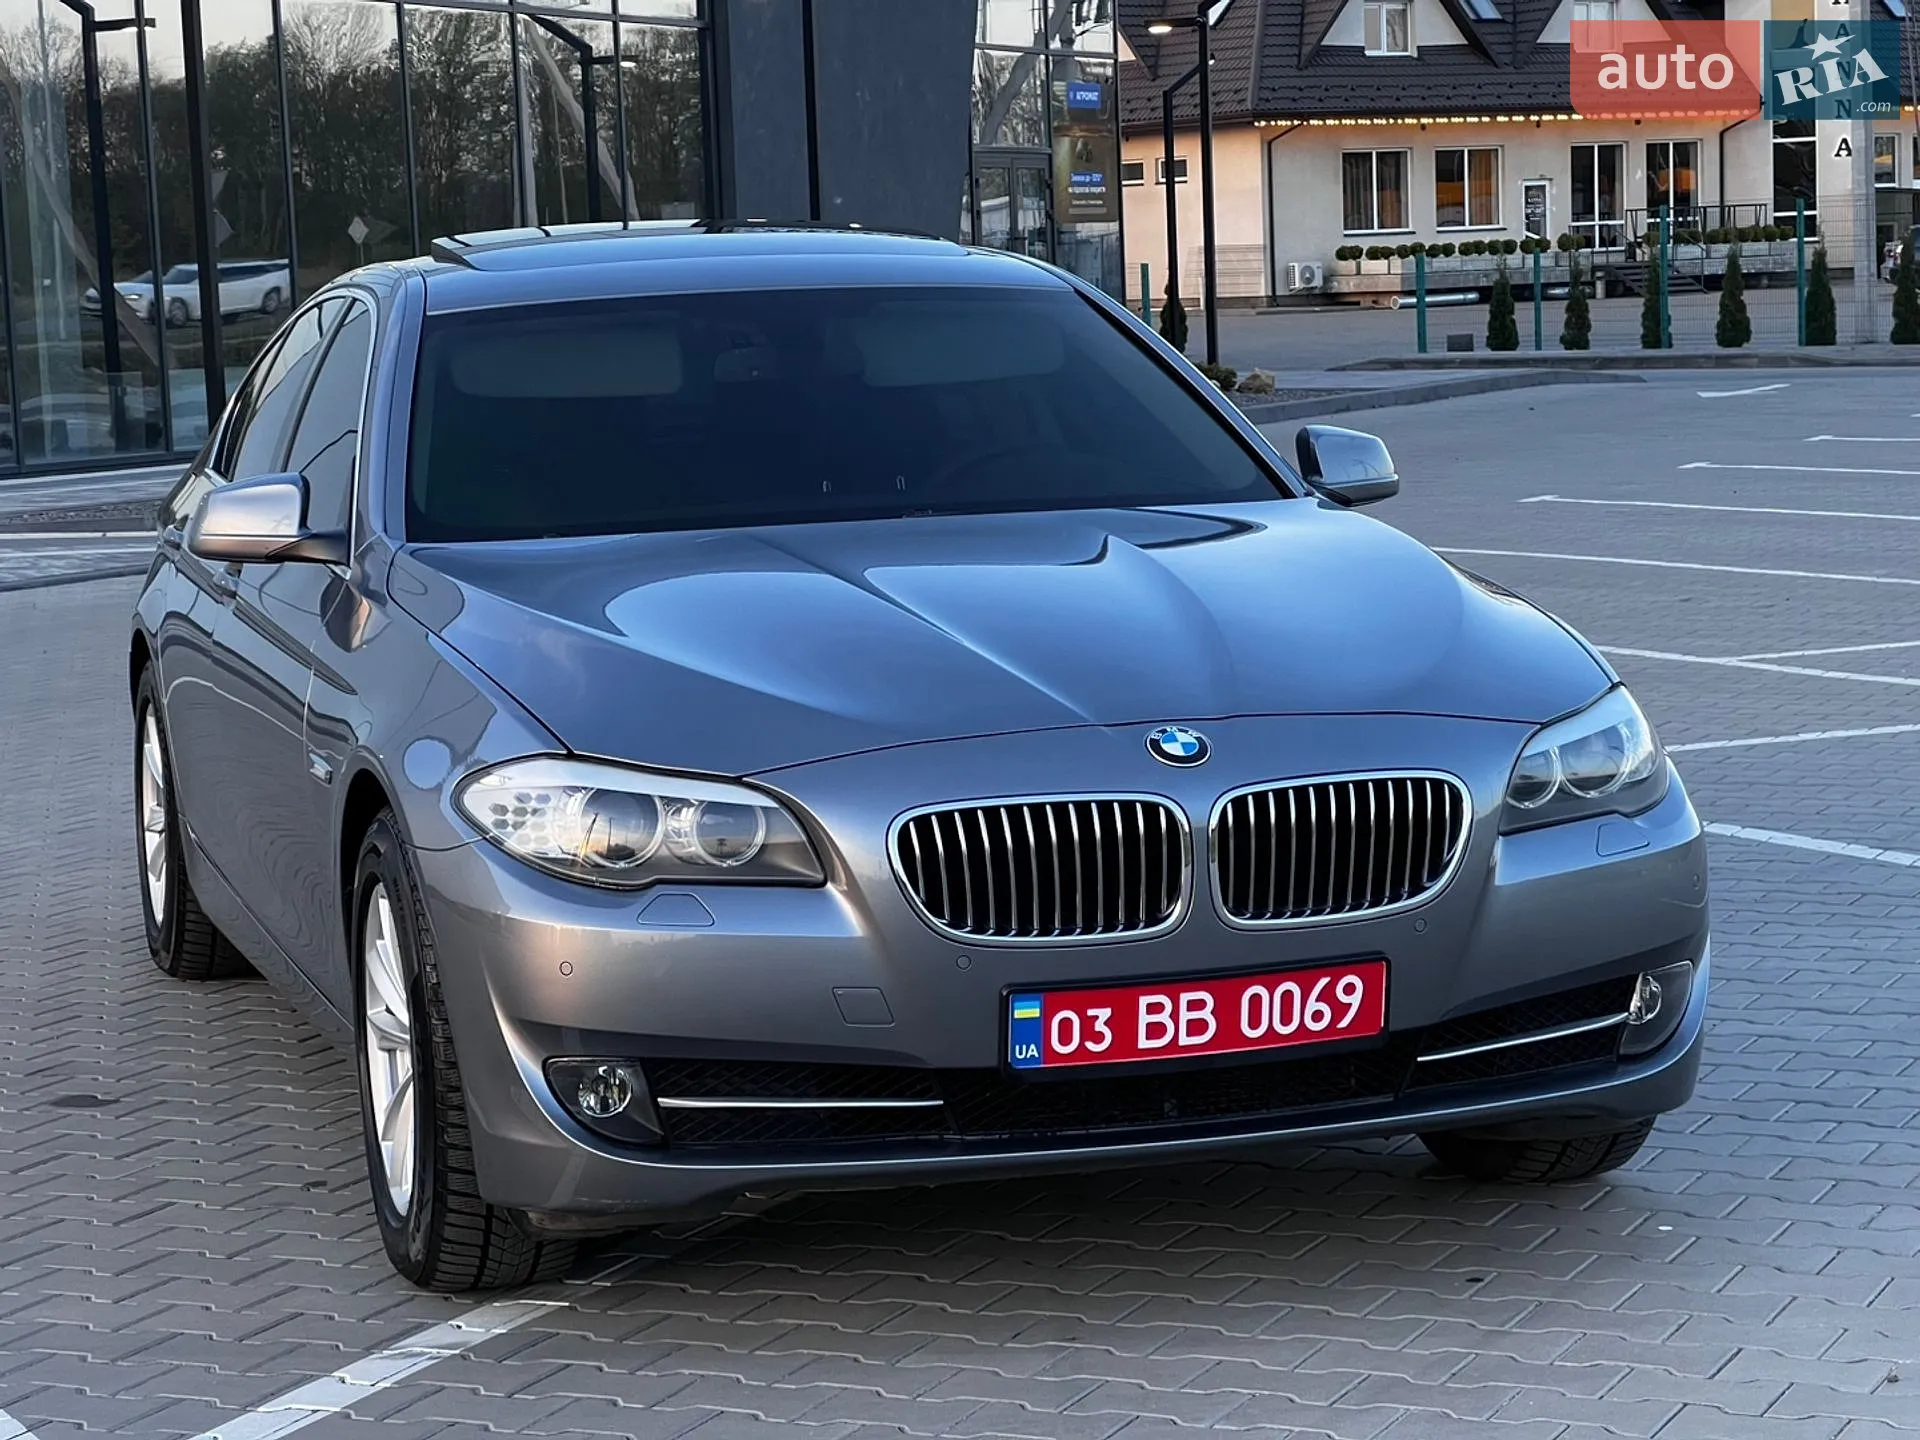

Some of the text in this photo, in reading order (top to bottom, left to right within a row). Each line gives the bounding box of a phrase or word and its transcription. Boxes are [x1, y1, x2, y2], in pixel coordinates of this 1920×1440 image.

[1832, 0, 1852, 158] ANNA
[1015, 1043, 1039, 1060] UA
[1050, 974, 1364, 1055] 03 BB 0069
